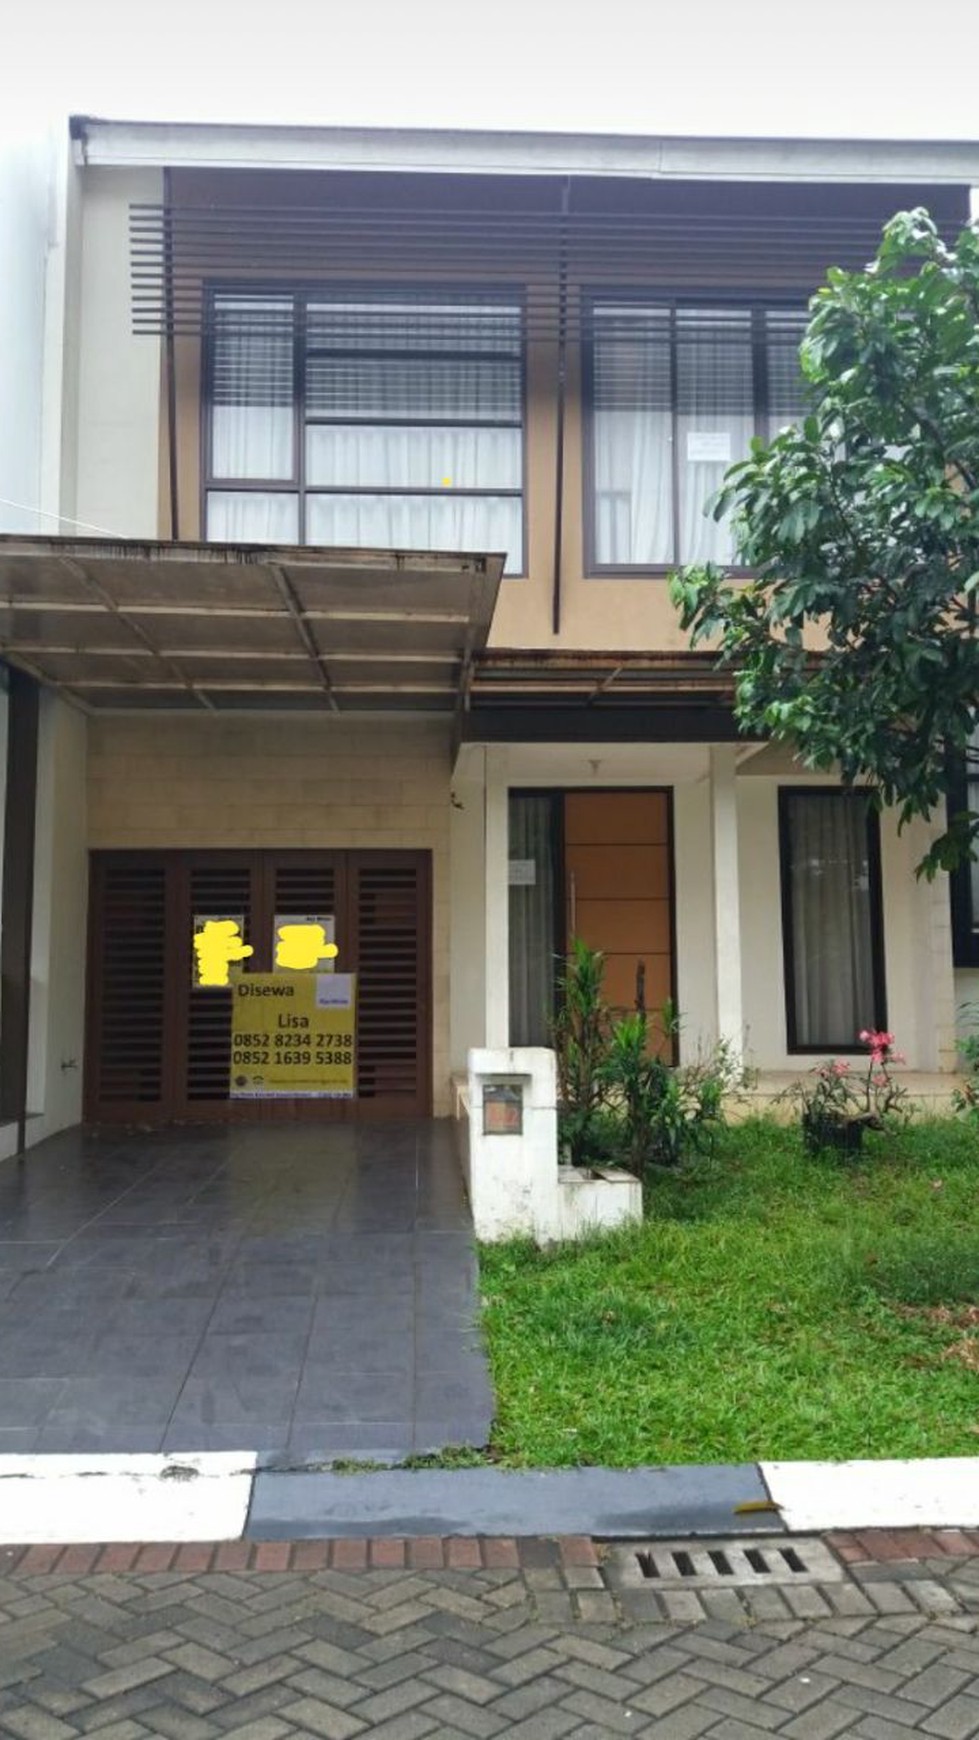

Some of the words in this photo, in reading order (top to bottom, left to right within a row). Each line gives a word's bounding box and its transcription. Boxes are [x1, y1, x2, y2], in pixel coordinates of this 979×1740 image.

[238, 983, 294, 997] Disewa
[278, 1013, 309, 1029] Lisa
[234, 1034, 269, 1047] 0852
[274, 1034, 311, 1047] 8234
[316, 1034, 352, 1047] 2738
[233, 1051, 270, 1065] 0852
[275, 1051, 311, 1065] 1639
[316, 1051, 352, 1065] 5388
